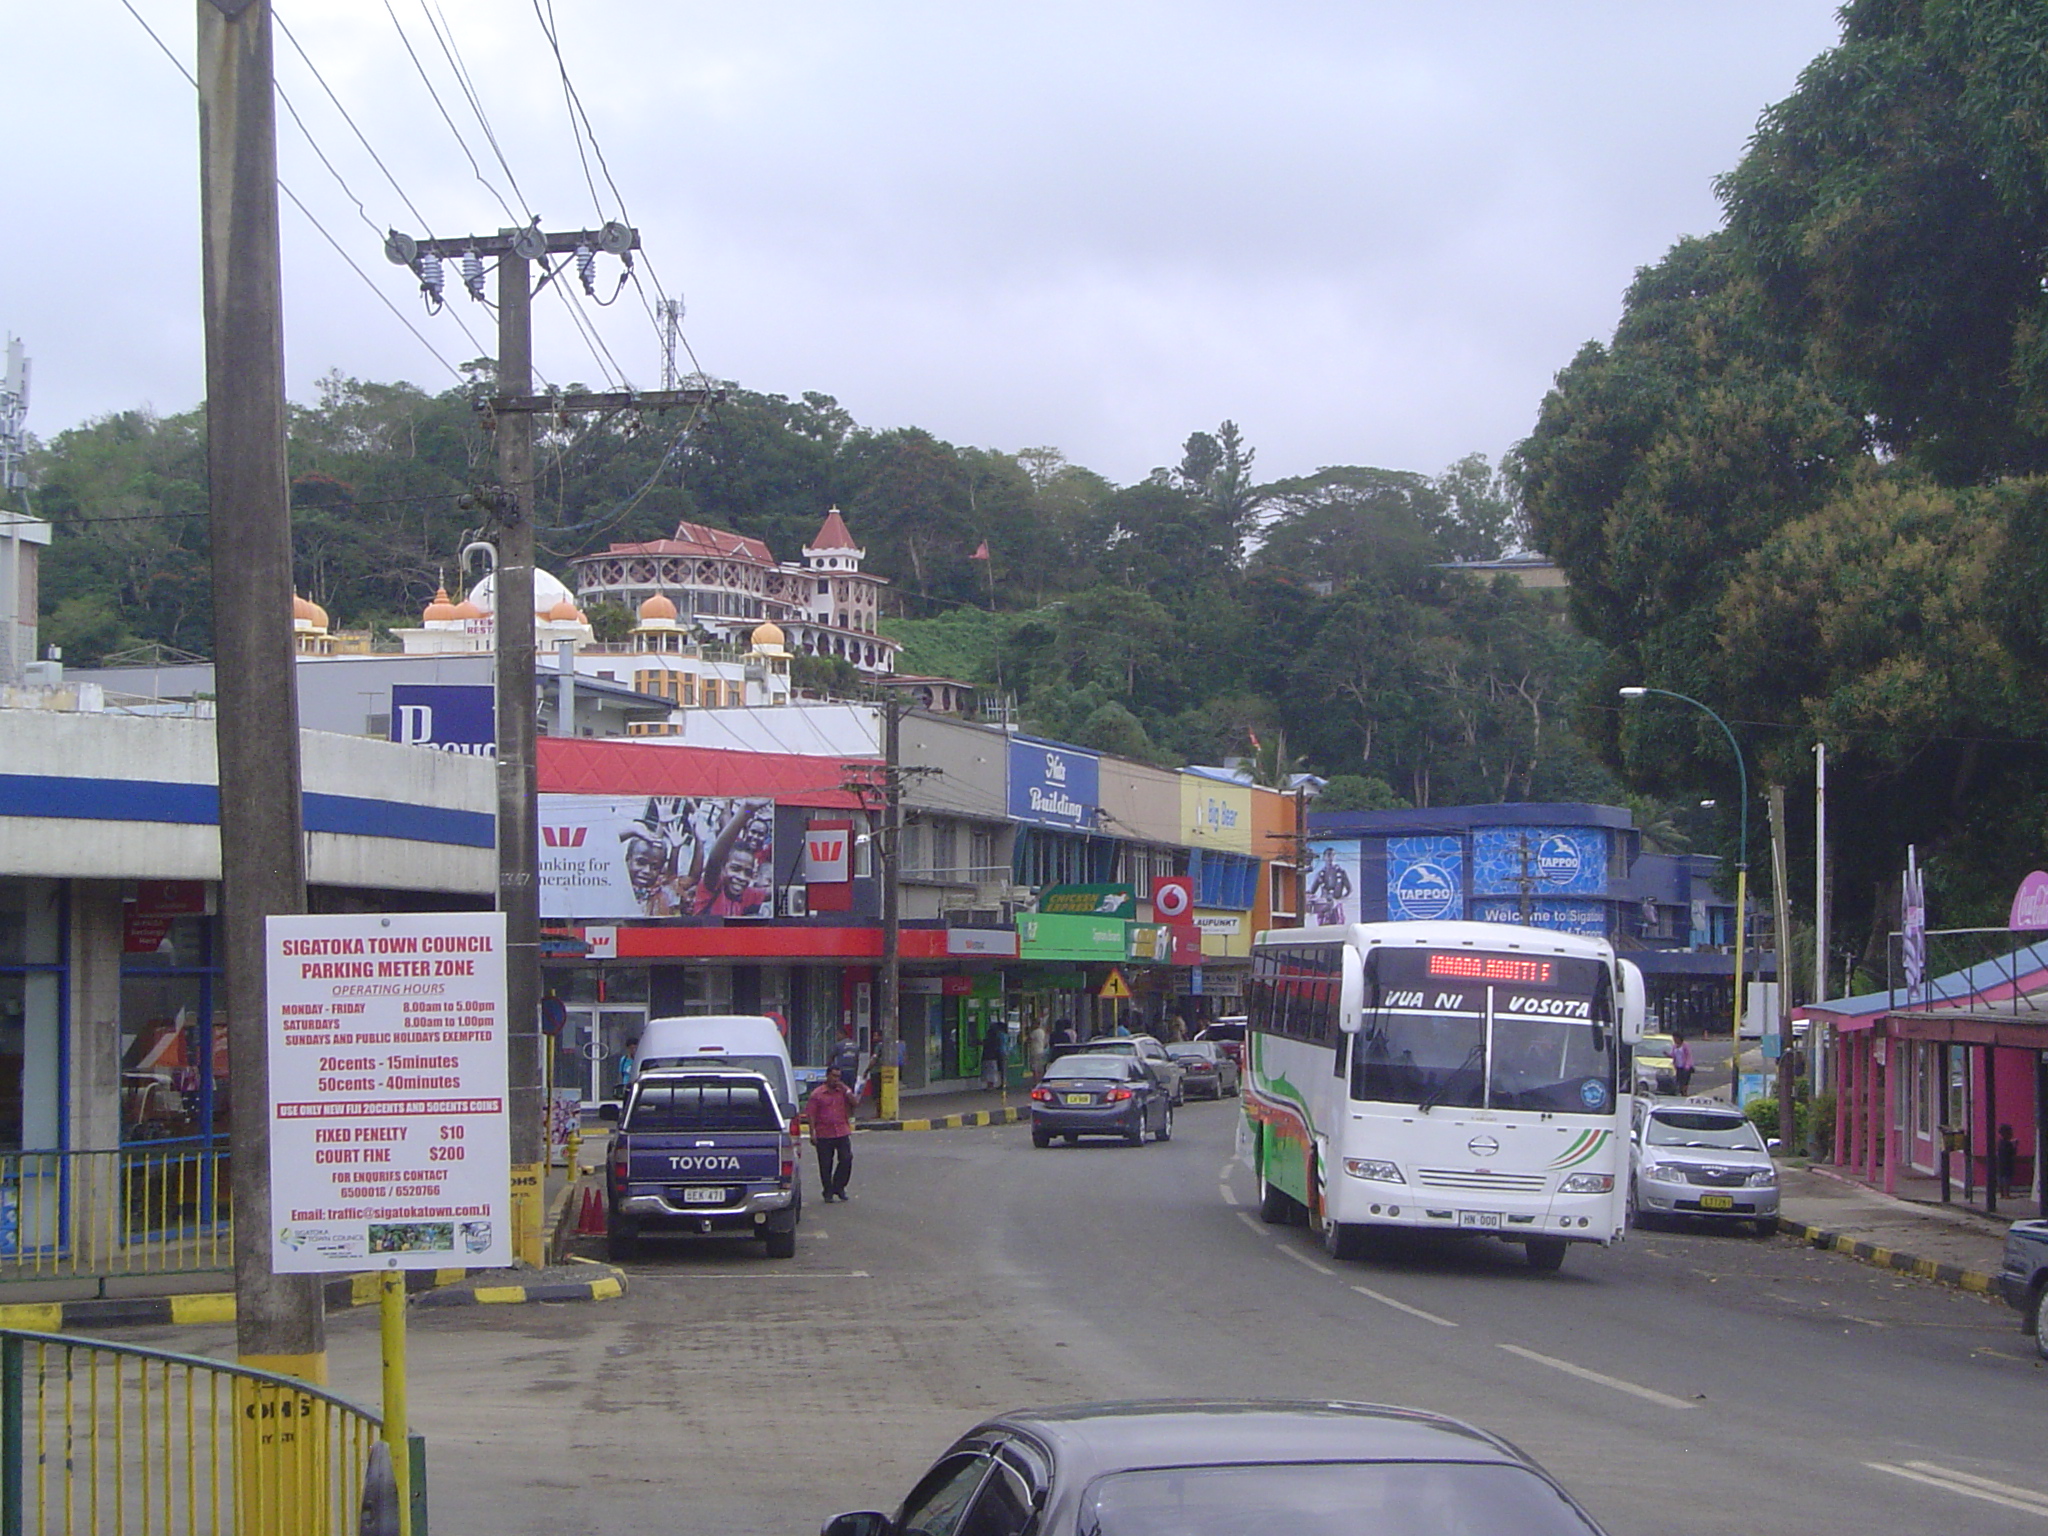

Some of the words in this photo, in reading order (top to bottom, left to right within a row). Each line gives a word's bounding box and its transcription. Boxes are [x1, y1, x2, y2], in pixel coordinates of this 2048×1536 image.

[1029, 787, 1082, 823] Building
[1208, 798, 1219, 832] Big
[589, 858, 610, 871] for
[1540, 857, 1579, 868] TAPPOO
[539, 874, 612, 886] nerations.
[1400, 888, 1450, 900] TAPPOO
[1193, 918, 1238, 926] LAUPUNKT
[1485, 909, 1550, 922] Welcme
[1554, 910, 1566, 922] to
[282, 938, 364, 956] SIGATOKA
[368, 937, 417, 954] TOWN
[422, 936, 493, 953] COUNCIL
[302, 962, 374, 979] PARKING
[378, 961, 430, 977] METER
[434, 960, 474, 976] ZONE
[332, 984, 400, 996] OPERATING
[403, 984, 445, 994] HOURS
[282, 1004, 324, 1015] MONDAY
[332, 1003, 365, 1014] FRIDAY
[403, 1002, 442, 1012] 8.00am
[444, 1002, 454, 1011] to
[456, 1001, 495, 1012] 5.00pm
[1384, 990, 1425, 1008] VUA
[1434, 993, 1464, 1010] NI
[1508, 996, 1591, 1018] VOSOTA
[283, 1019, 340, 1030] SATURDAYS
[404, 1018, 443, 1027] 8.00am
[445, 1018, 455, 1027] to
[457, 1016, 494, 1027] 1.00pm
[285, 1034, 330, 1045] SUNDAYS
[333, 1034, 353, 1044] AND
[355, 1033, 391, 1044] PUBLIC
[393, 1032, 440, 1043] HOLIDAYS
[443, 1031, 492, 1042] EXEMPTED
[319, 1056, 376, 1071] 20cents
[387, 1055, 459, 1069] 15minutes
[318, 1077, 375, 1091] 50cents
[386, 1075, 460, 1090] 40minutes
[1690, 1097, 1712, 1105] TAXI
[300, 1104, 322, 1115] ONLY
[323, 1104, 344, 1114] NEW
[345, 1103, 362, 1114] FIJI
[363, 1103, 404, 1114] 20CENTS
[406, 1102, 425, 1112] AND
[427, 1102, 468, 1112] 50CENTS
[315, 1128, 350, 1143] FIXED
[355, 1127, 408, 1142] PENELTY
[440, 1125, 464, 1140] $10
[315, 1149, 360, 1164] COURT
[363, 1148, 391, 1163] FINE
[430, 1146, 465, 1161] $200
[669, 1156, 741, 1170] TOYOTA
[332, 1172, 351, 1183] FOR
[403, 1170, 448, 1181] CONTACT
[708, 1190, 723, 1200] 471
[291, 1209, 326, 1221] Email:
[328, 1204, 490, 1220] traffic@sigatokatown.com.fj
[1480, 1215, 1497, 1226] 000
